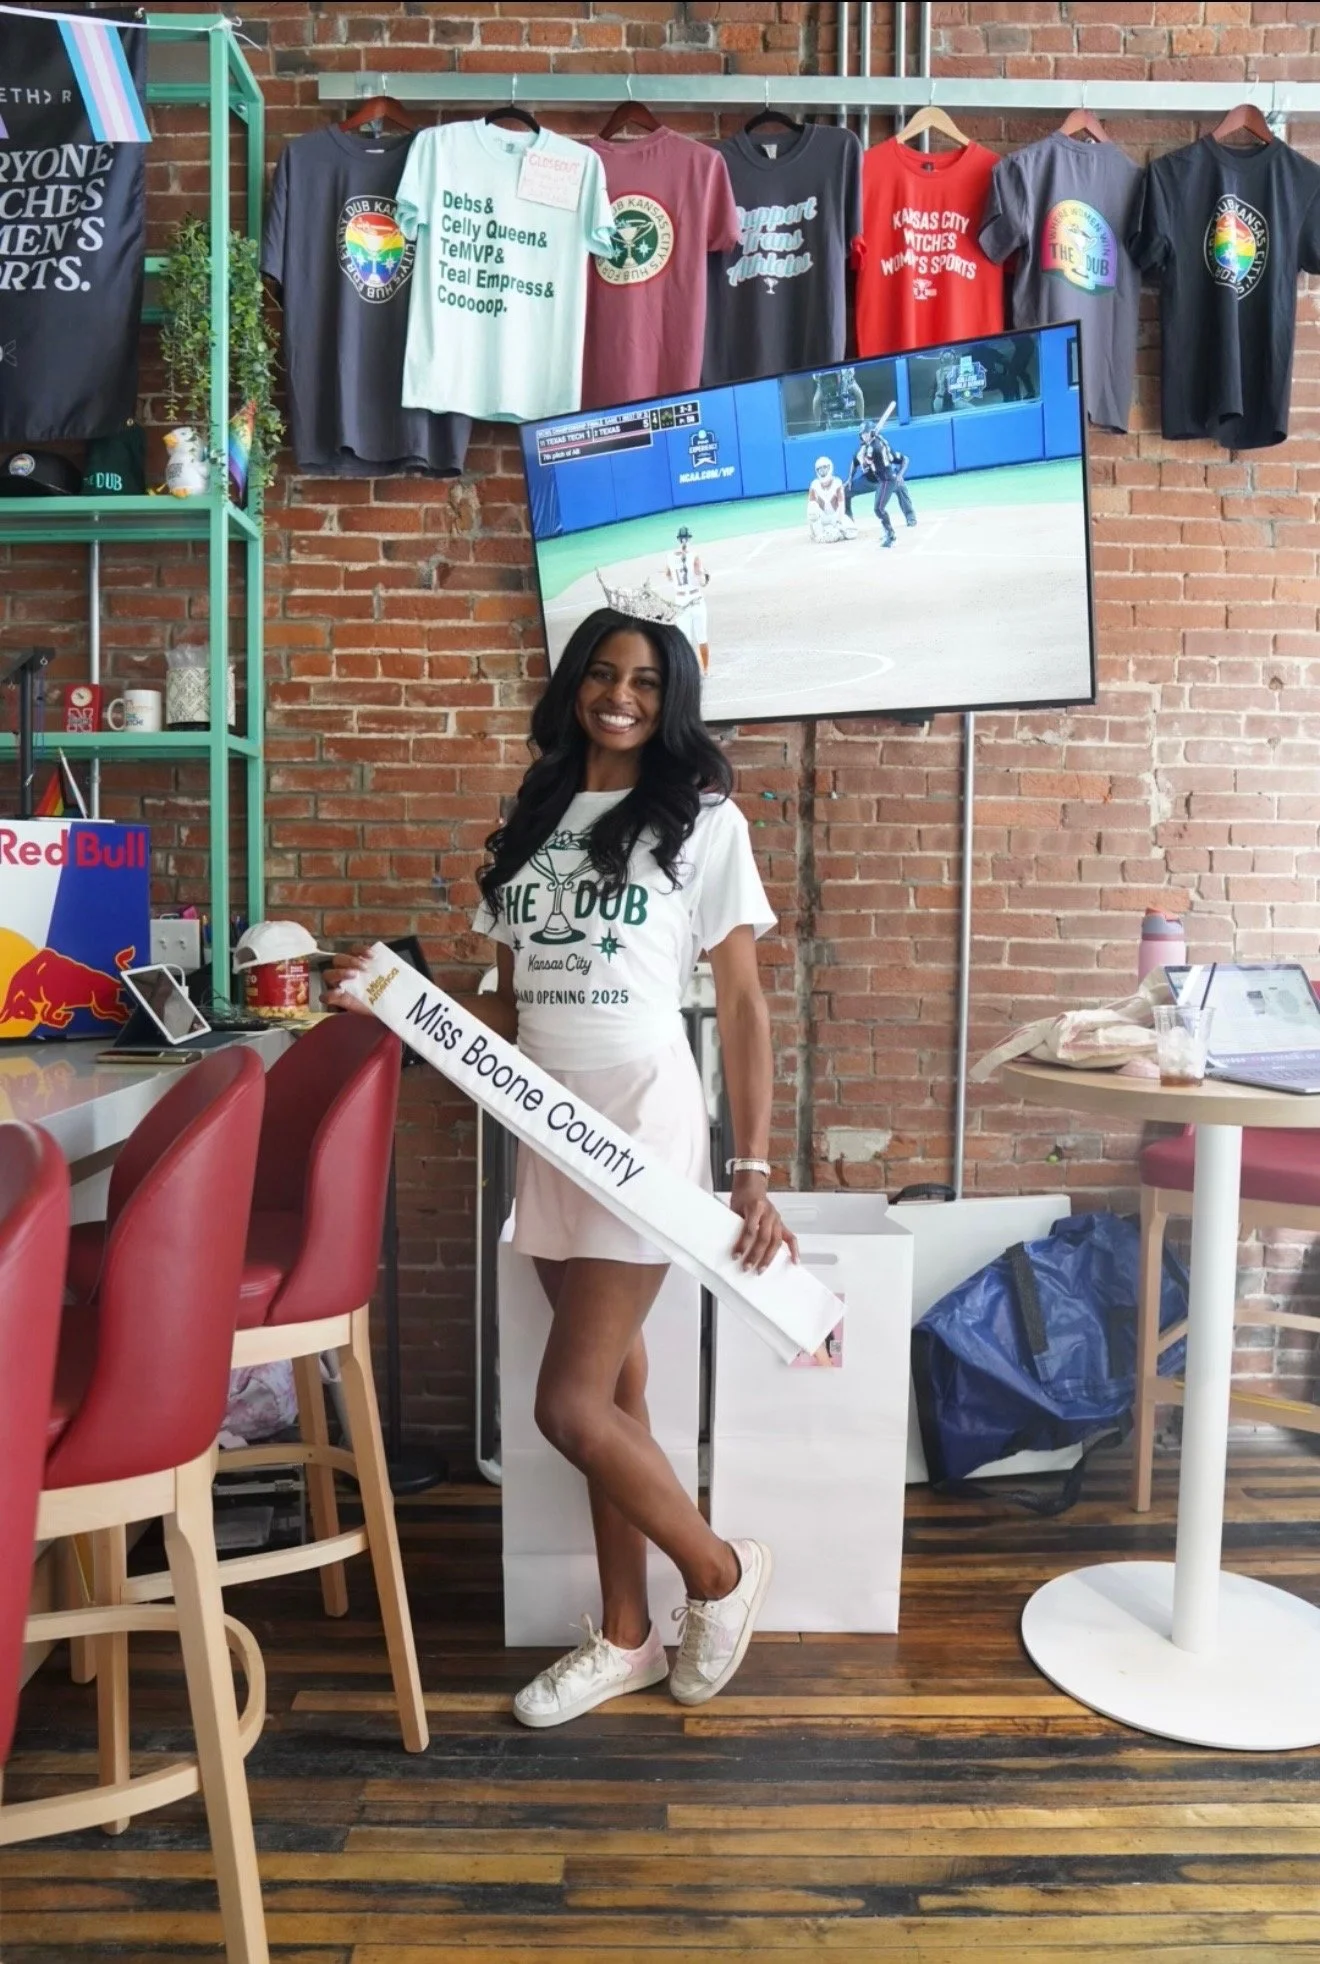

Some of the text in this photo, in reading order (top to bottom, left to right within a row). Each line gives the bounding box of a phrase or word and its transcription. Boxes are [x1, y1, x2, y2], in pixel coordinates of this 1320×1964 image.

[345, 200, 370, 217] DUB
[443, 190, 494, 214] Debs&
[612, 200, 624, 216] UB
[627, 198, 669, 229] KANSAS
[441, 214, 547, 248] Celly Queen&
[893, 207, 970, 234] KANSAS CITY
[440, 236, 505, 264] TeMVP&
[903, 227, 957, 252] WTCHES
[930, 253, 977, 280] SPORTS
[1048, 242, 1109, 276] THE DUB
[0, 256, 91, 292] RTS.
[346, 263, 365, 291] FOR
[439, 260, 554, 298] Teal Empress&
[623, 269, 649, 280] HUB
[367, 286, 393, 298] HUB
[96, 472, 123, 491] DUB
[0, 828, 146, 869] Red Bull
[501, 880, 649, 926] HE DUB
[527, 953, 593, 976] Kansas City
[537, 990, 586, 1005] OPENING
[591, 989, 629, 1004] 2025
[405, 992, 645, 1188] Miss Boone County
